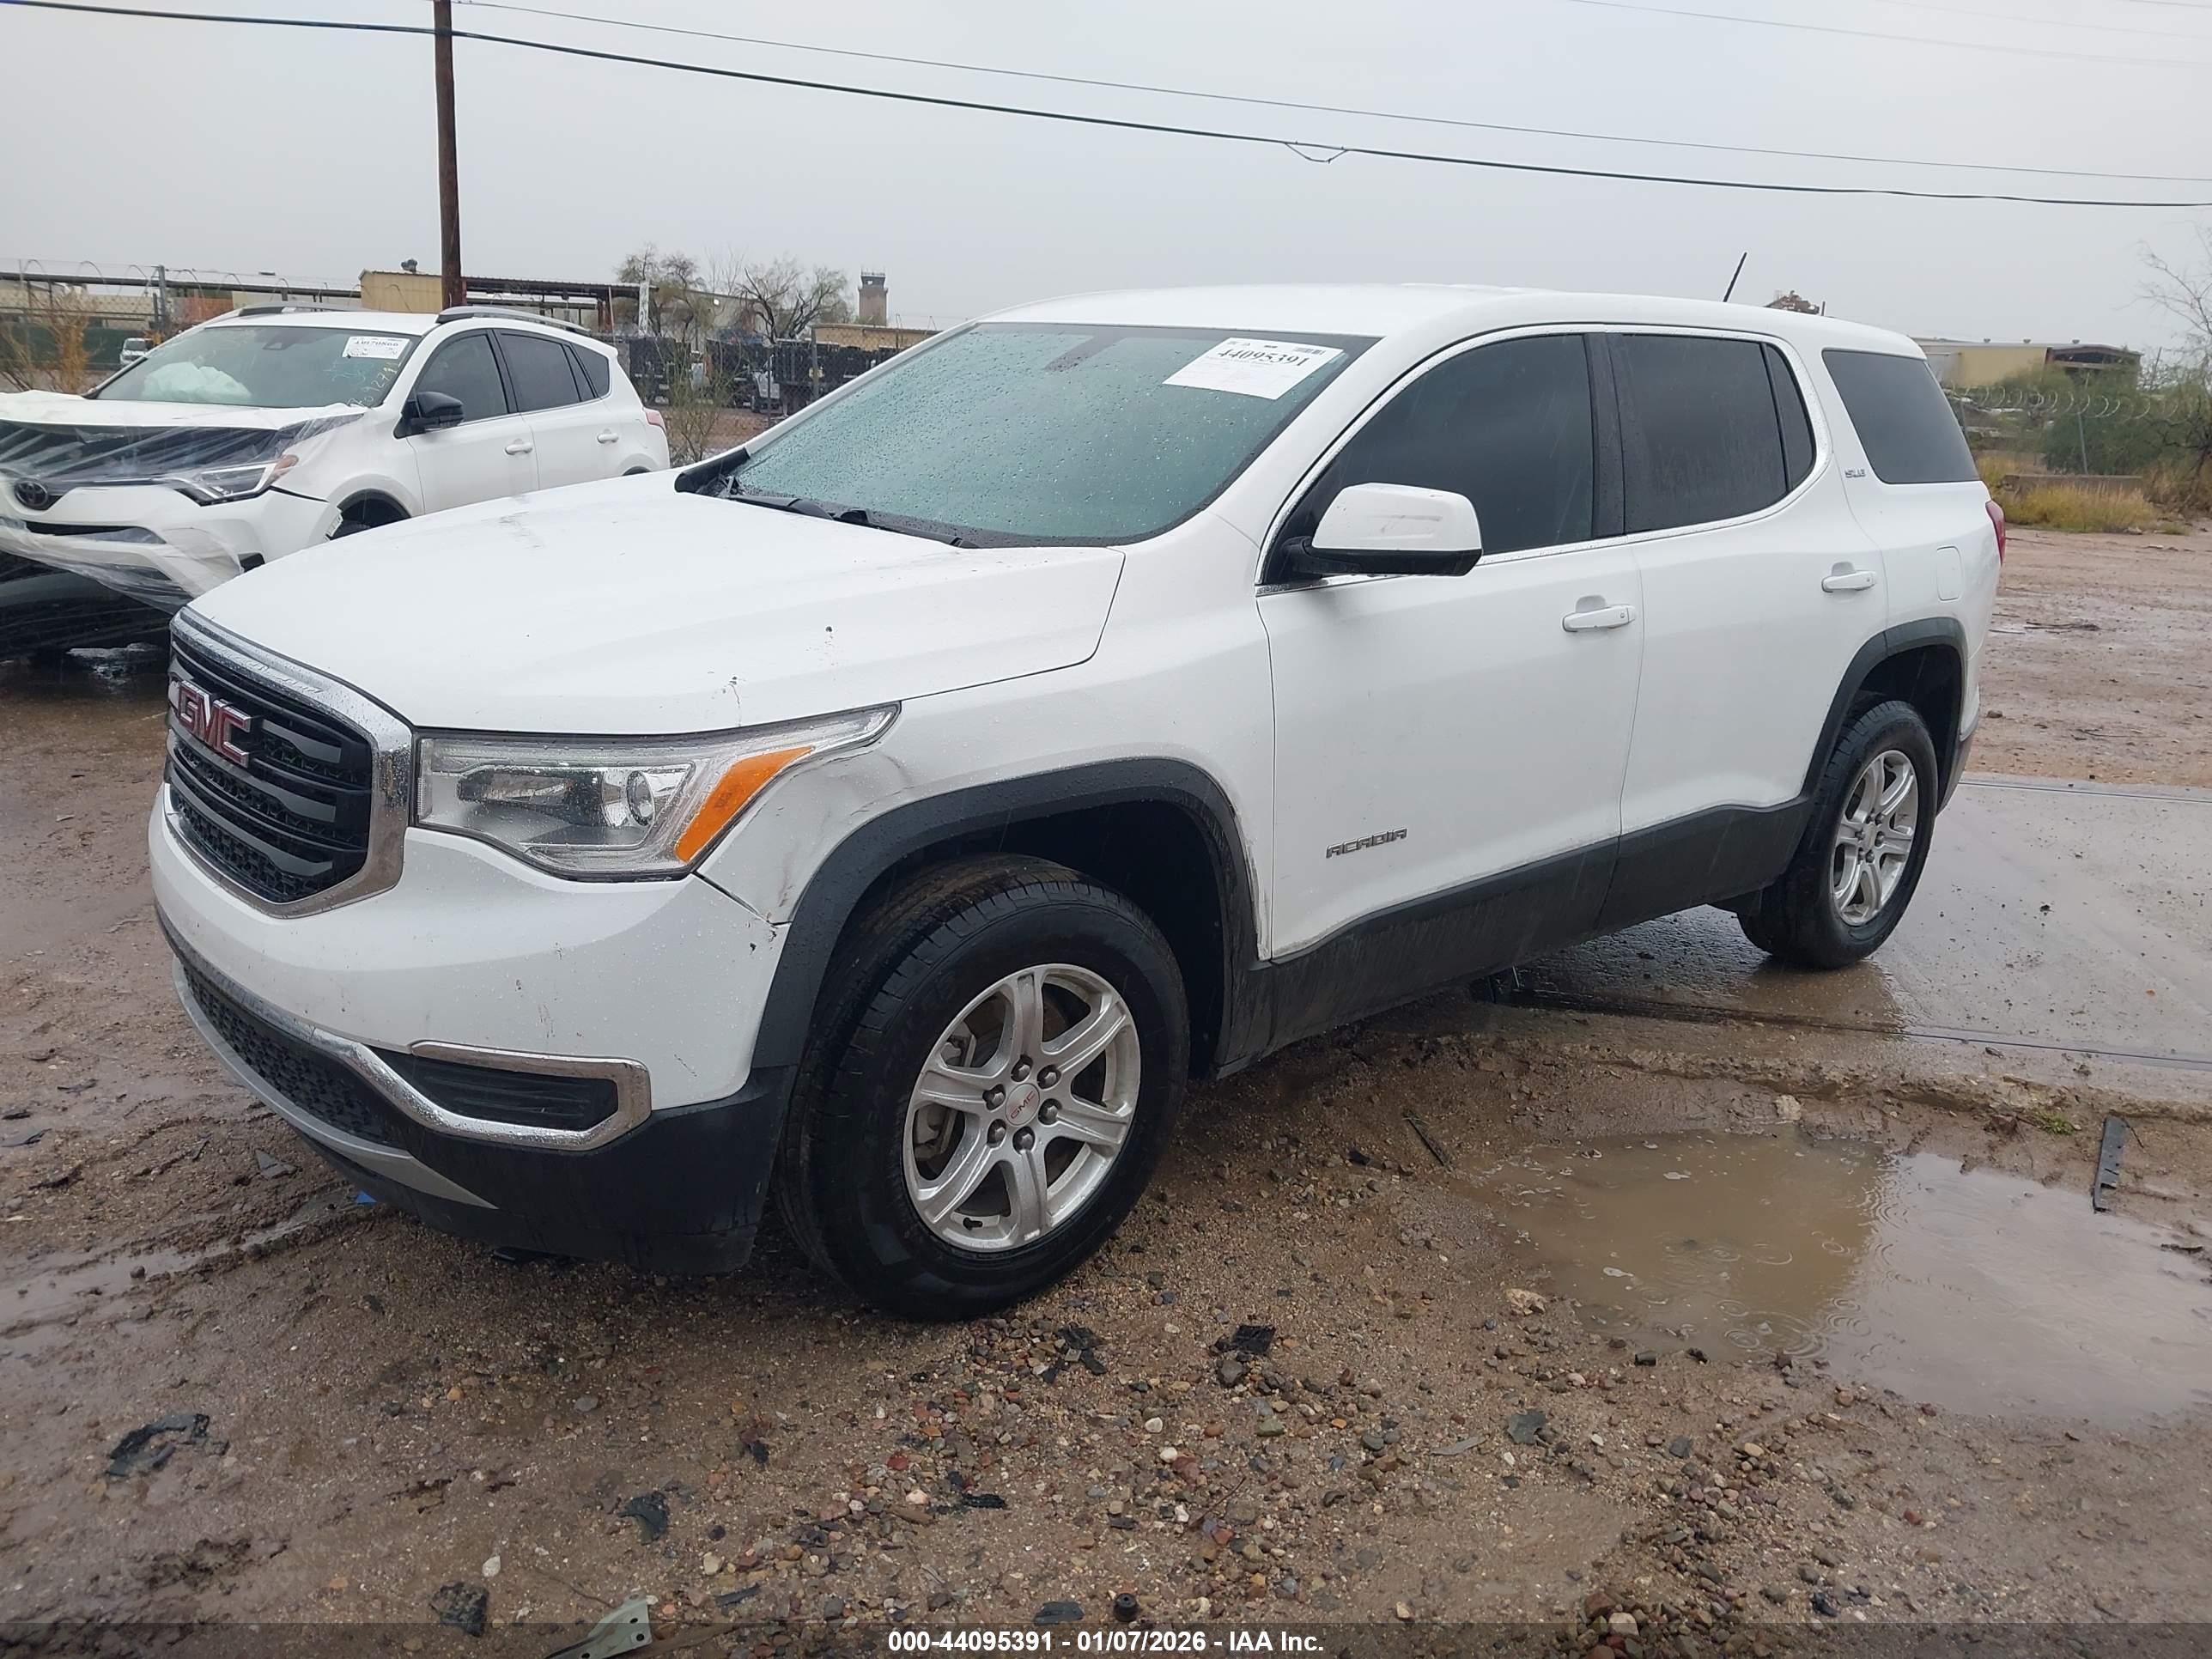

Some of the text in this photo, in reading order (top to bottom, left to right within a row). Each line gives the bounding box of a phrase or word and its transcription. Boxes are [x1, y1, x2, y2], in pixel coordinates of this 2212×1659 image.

[1217, 349, 1310, 366] 44095391
[177, 680, 252, 768] GMC
[1326, 826, 1408, 859] ACADIA
[1011, 1091, 1036, 1119] GMC
